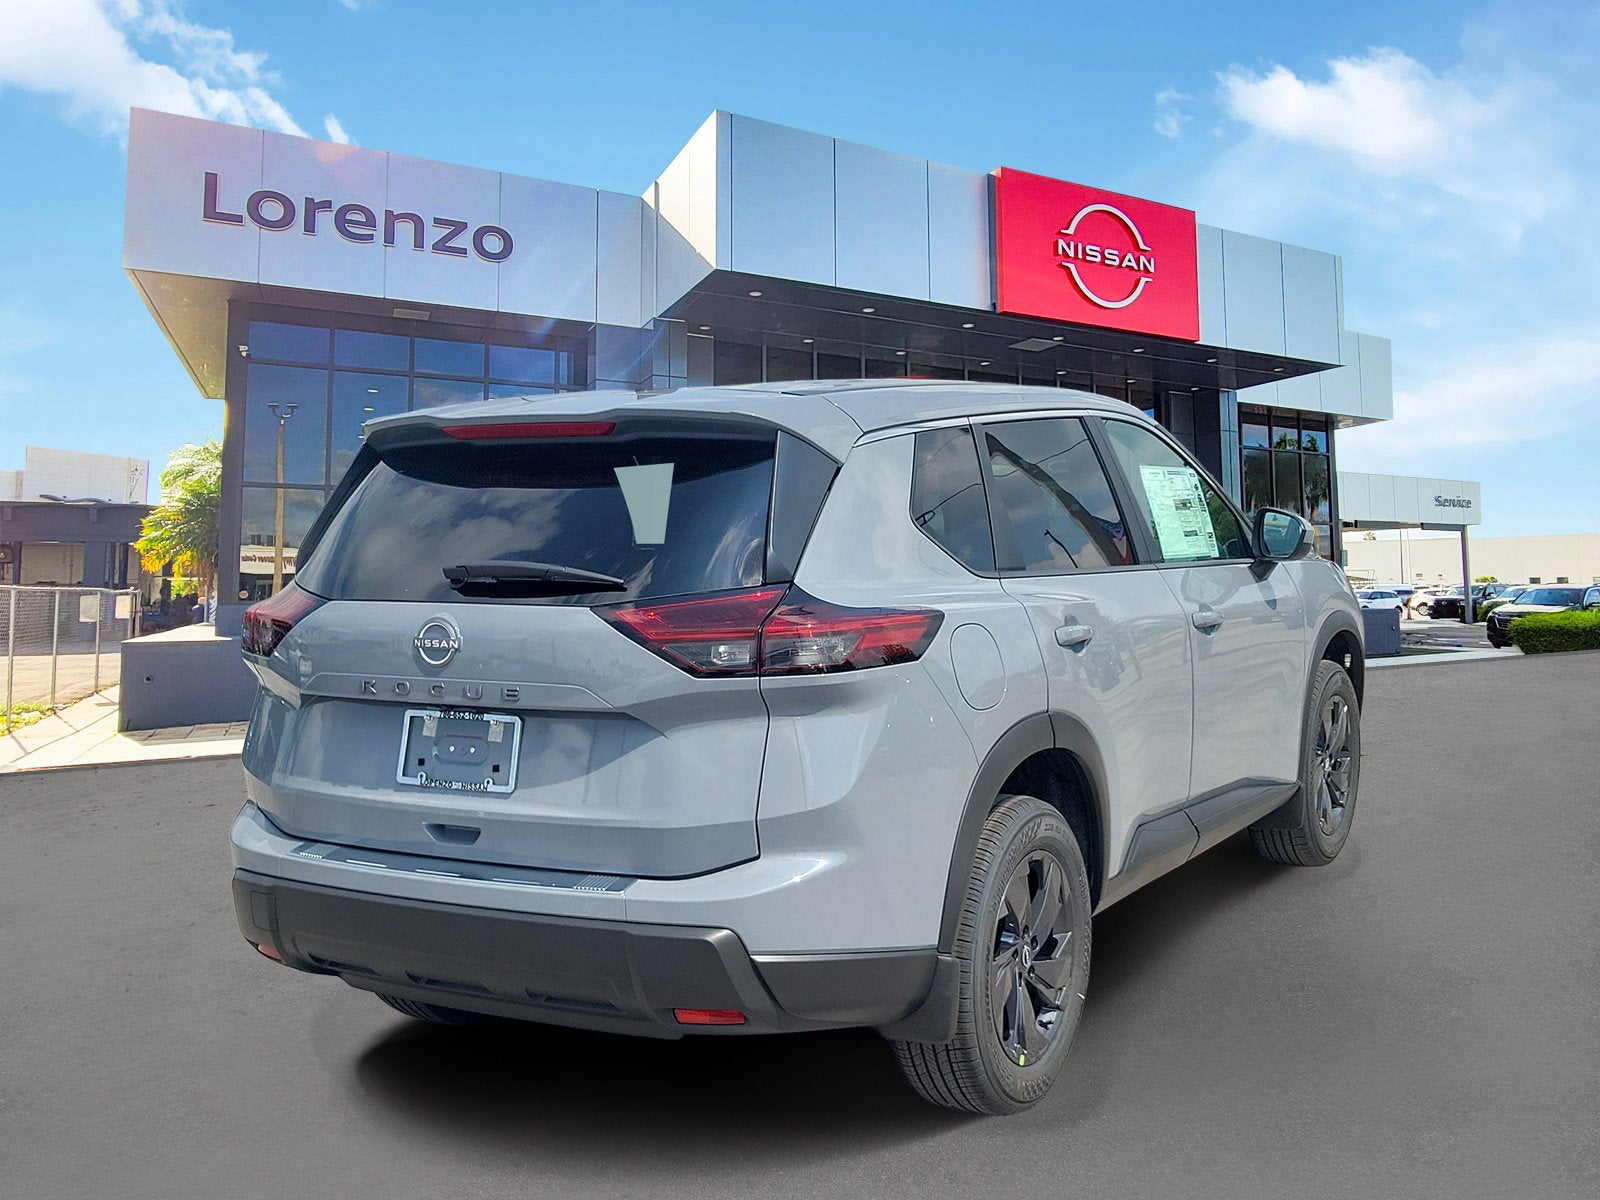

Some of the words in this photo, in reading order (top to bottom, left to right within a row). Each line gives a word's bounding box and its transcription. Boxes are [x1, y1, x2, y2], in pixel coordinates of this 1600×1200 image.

[203, 171, 514, 262] Lorenzo
[1057, 238, 1155, 273] NISSAN
[1434, 495, 1472, 508] Service
[414, 638, 459, 649] NISSAN
[361, 679, 520, 701] ROGUE
[461, 781, 488, 792] NISSAN
